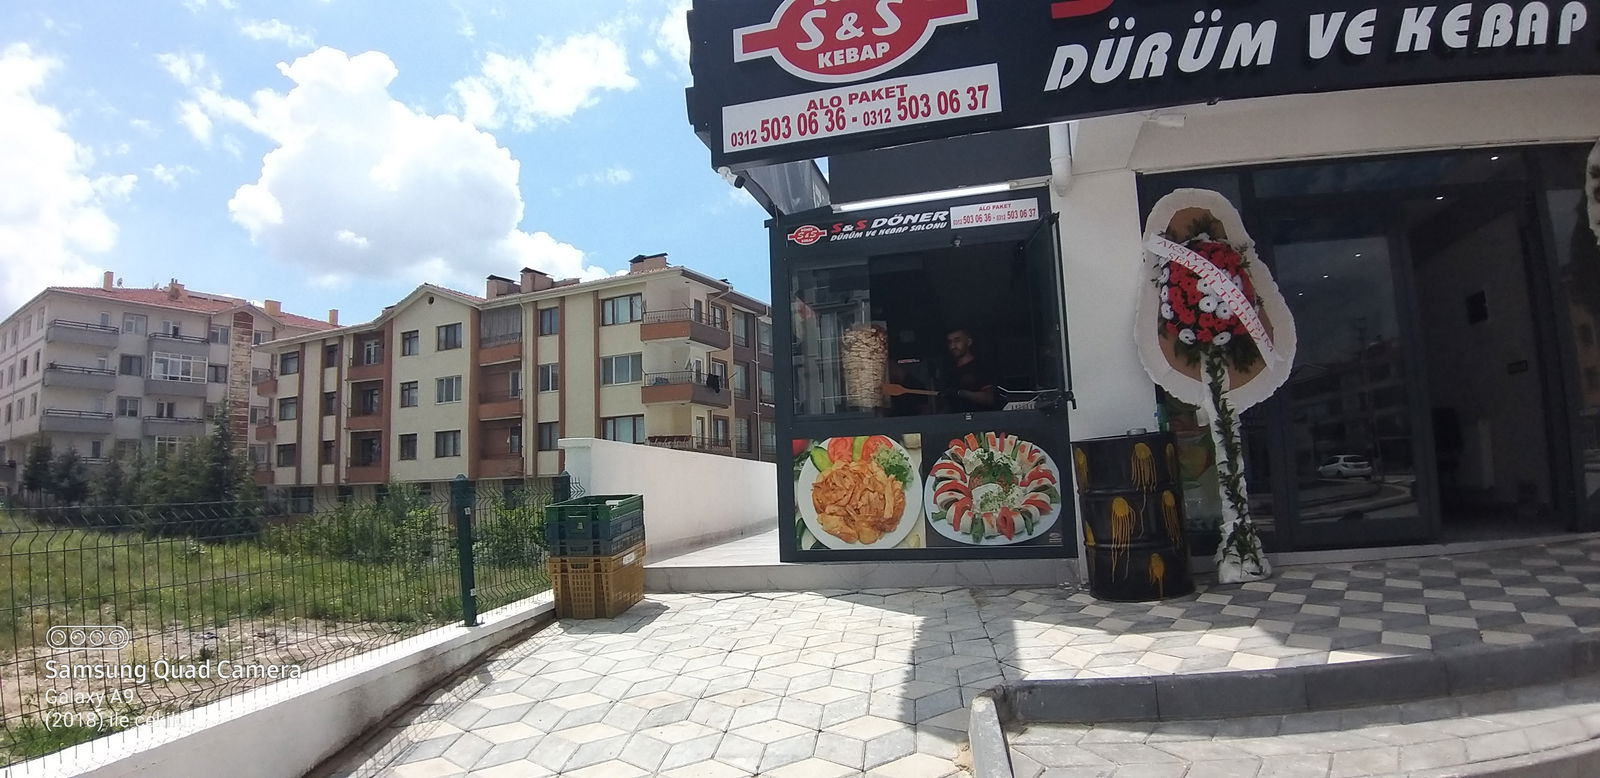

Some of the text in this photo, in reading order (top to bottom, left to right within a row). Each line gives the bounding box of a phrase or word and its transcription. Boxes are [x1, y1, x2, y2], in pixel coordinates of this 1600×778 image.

[818, 42, 890, 69] KEBAP
[1043, 1, 1588, 92] DÜRÜM VE KEBAP
[806, 84, 908, 112] ALO PAKET
[730, 129, 757, 148] 0312
[760, 116, 792, 142] 503
[797, 112, 819, 136] 06
[825, 107, 846, 133] 36
[863, 108, 891, 126] 0312
[897, 94, 931, 121] 503
[937, 89, 960, 115] 06
[967, 84, 989, 110] 37
[871, 210, 949, 229] DÖNER
[963, 215, 974, 225] 503
[1007, 210, 1018, 219] 503
[1019, 209, 1028, 218] 06
